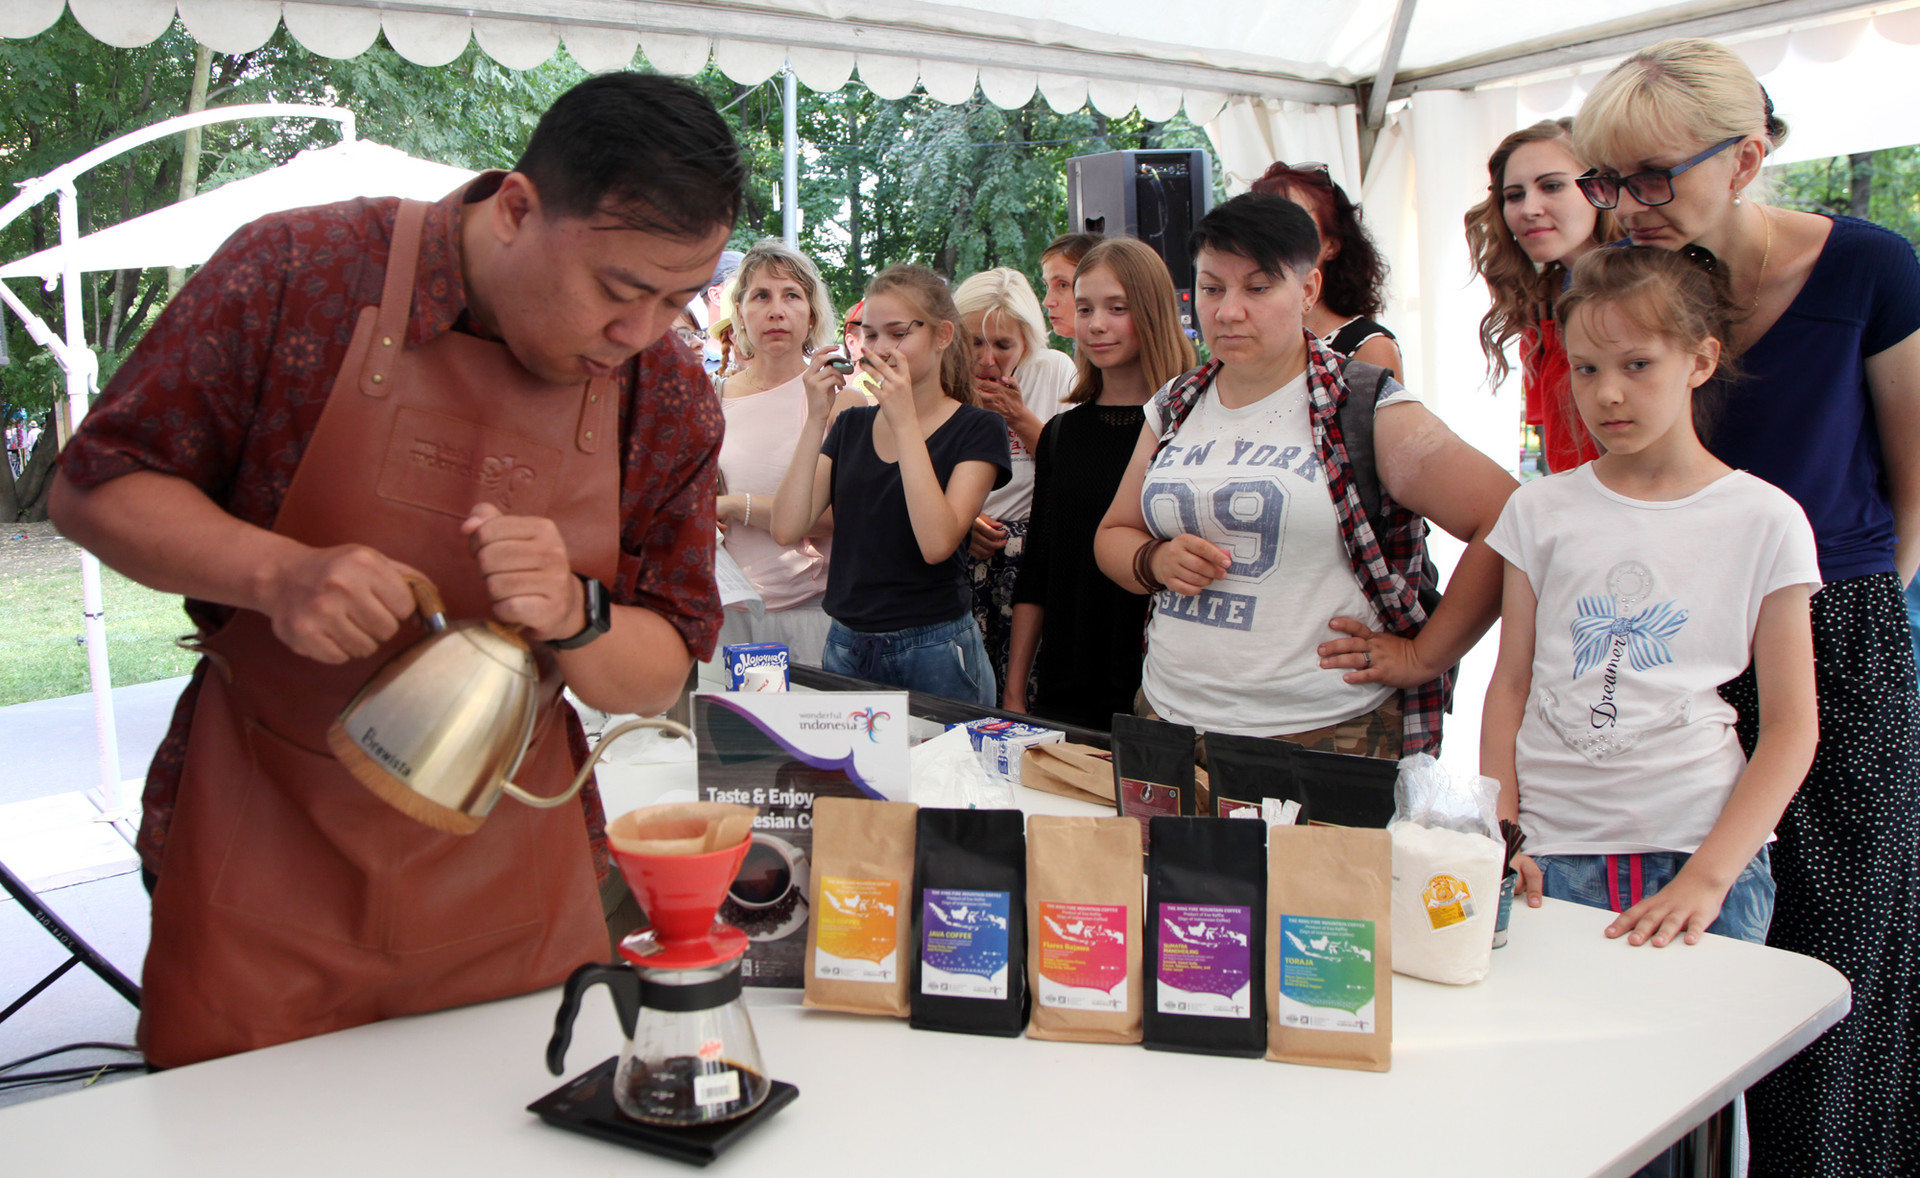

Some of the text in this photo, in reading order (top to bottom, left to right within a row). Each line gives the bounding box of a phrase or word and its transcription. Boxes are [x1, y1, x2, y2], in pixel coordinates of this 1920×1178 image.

[1156, 440, 1320, 483] EW YORK
[1141, 475, 1291, 584] 09
[1161, 592, 1246, 624] STATE
[1590, 636, 1626, 729] Dreamer
[798, 711, 842, 720] wonderful
[800, 720, 857, 730] indonesia
[362, 726, 412, 778] Brewista
[706, 787, 814, 809] Taste & Enjoy
[751, 812, 794, 829] esian
[946, 931, 972, 939] COFFEE
[1043, 941, 1063, 950] Flores
[1285, 957, 1314, 966] TORAJA
